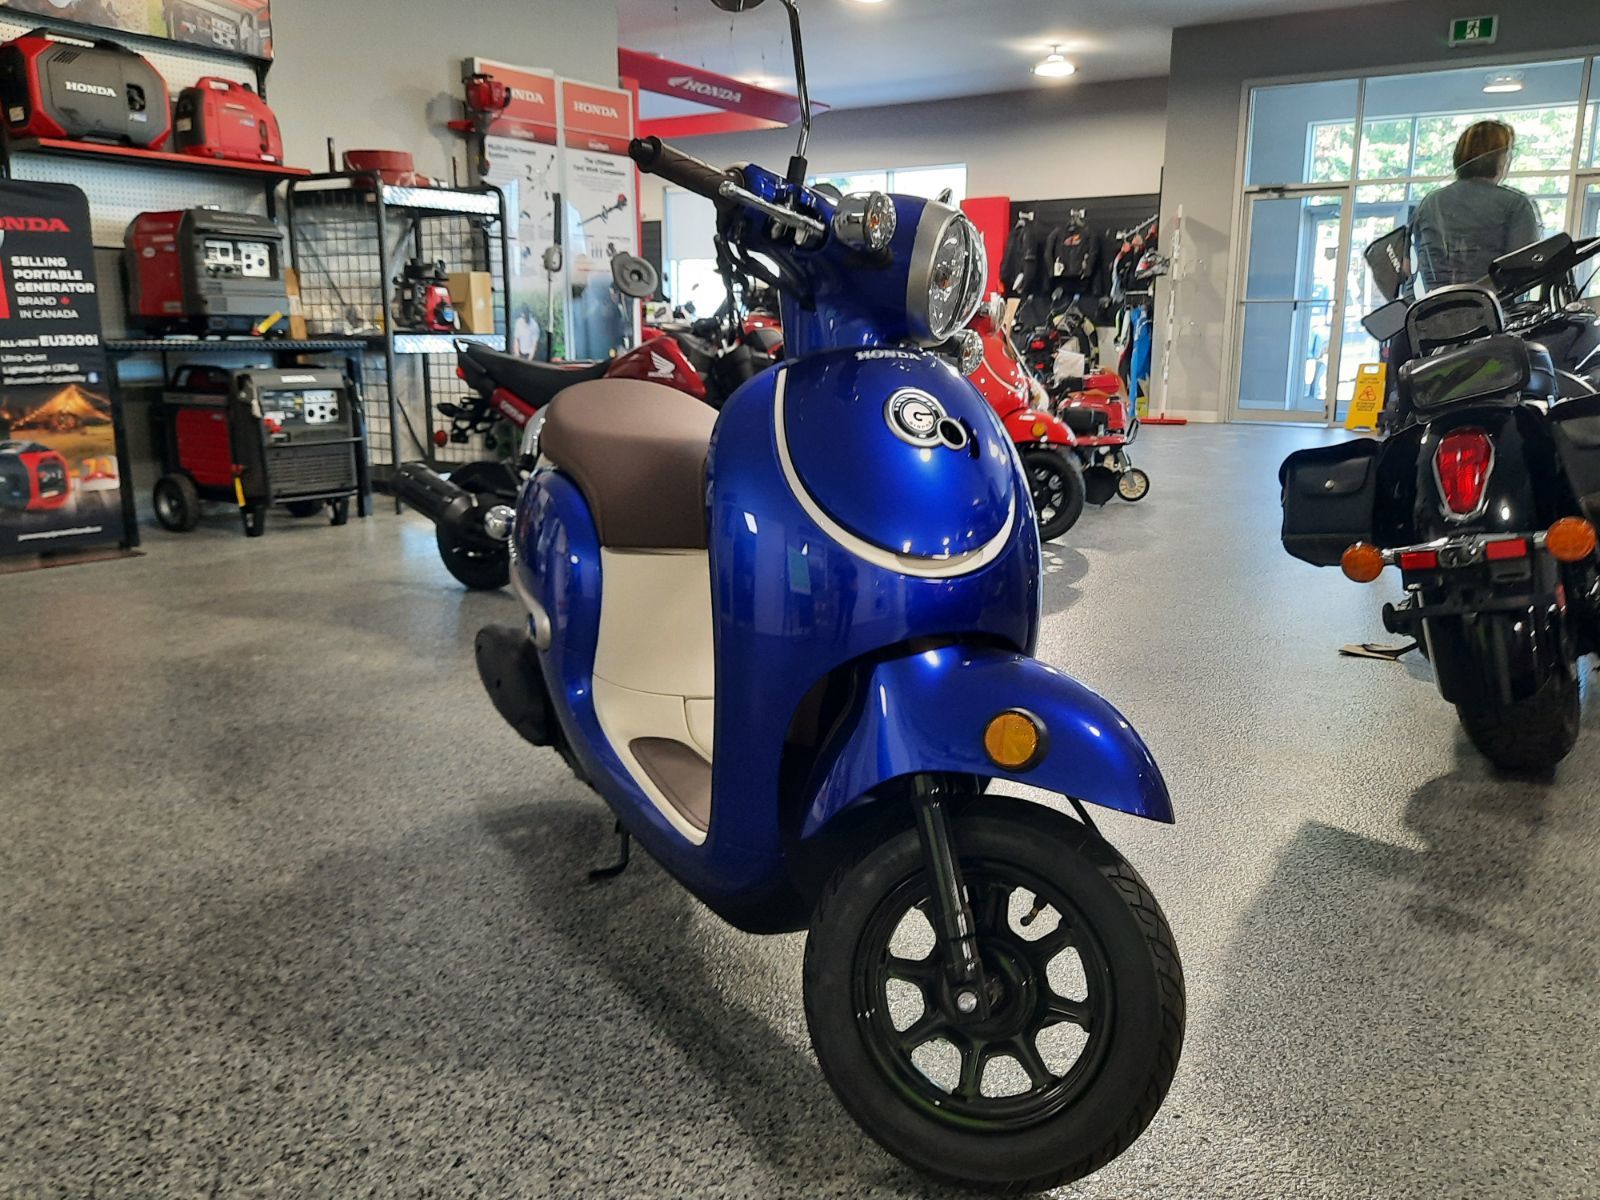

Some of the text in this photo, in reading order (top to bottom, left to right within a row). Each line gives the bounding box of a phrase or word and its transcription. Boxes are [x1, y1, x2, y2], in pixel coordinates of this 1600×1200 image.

[65, 81, 117, 98] HONDA
[685, 79, 742, 104] HONDA
[511, 88, 545, 105] NDA
[573, 101, 618, 119] HONDA
[0, 216, 70, 232] NDA
[11, 256, 67, 267] SELLING
[13, 270, 82, 280] PORTABLE
[15, 282, 95, 293] GENERATOR
[17, 296, 56, 306] BRAND
[20, 309, 79, 319] IN CANADA
[39, 334, 99, 346] EU3200i
